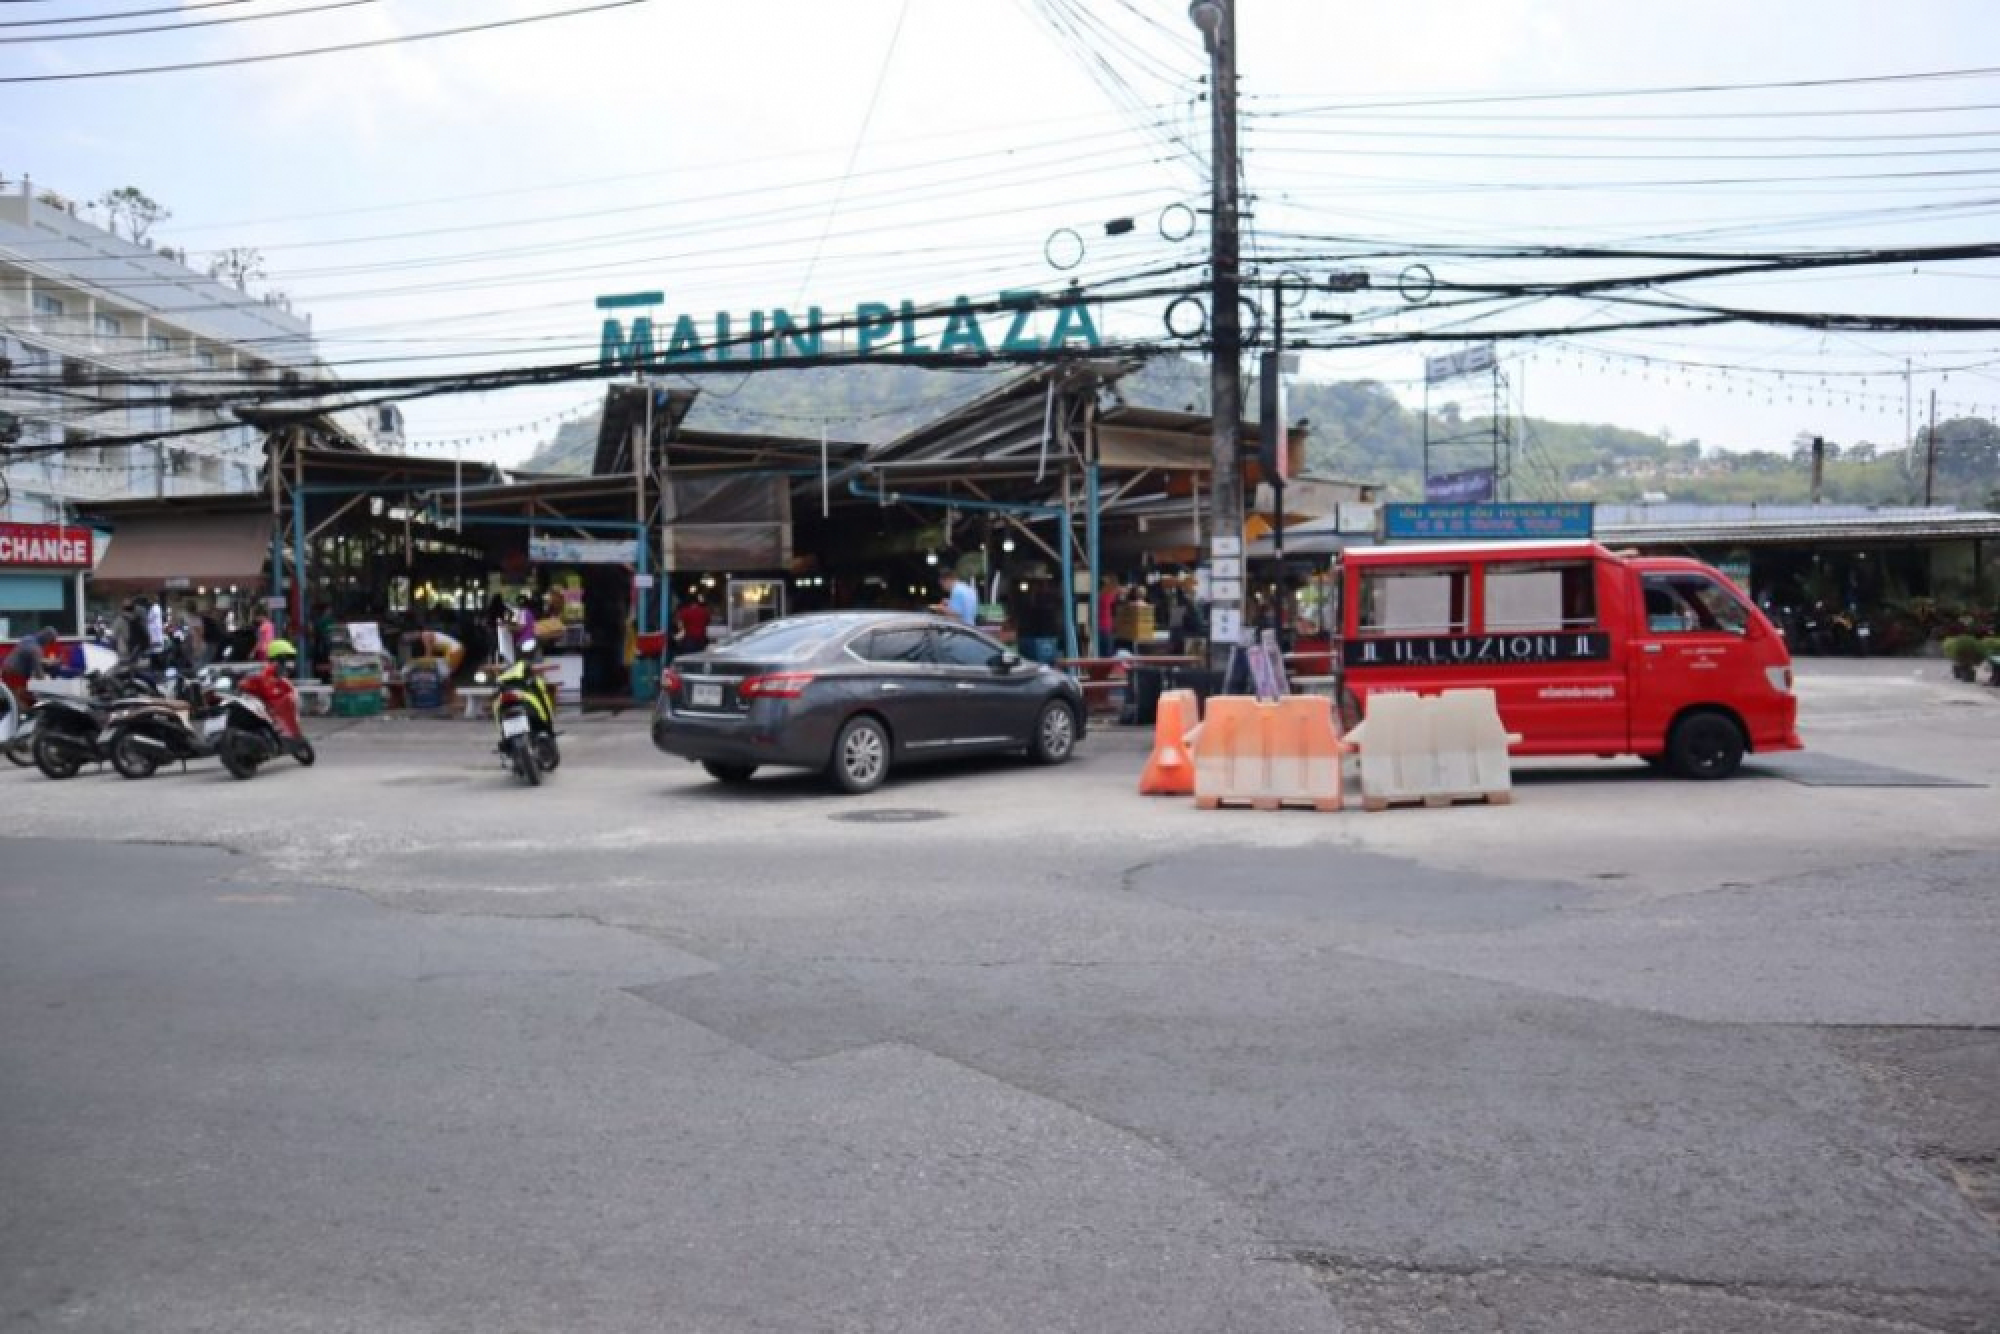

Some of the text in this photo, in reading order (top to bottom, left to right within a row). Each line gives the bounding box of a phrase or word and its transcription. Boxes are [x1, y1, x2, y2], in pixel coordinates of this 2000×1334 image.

[857, 290, 1101, 356] PLAZA
[0, 536, 87, 563] CHANGE
[1395, 636, 1557, 661] ILLUZION
